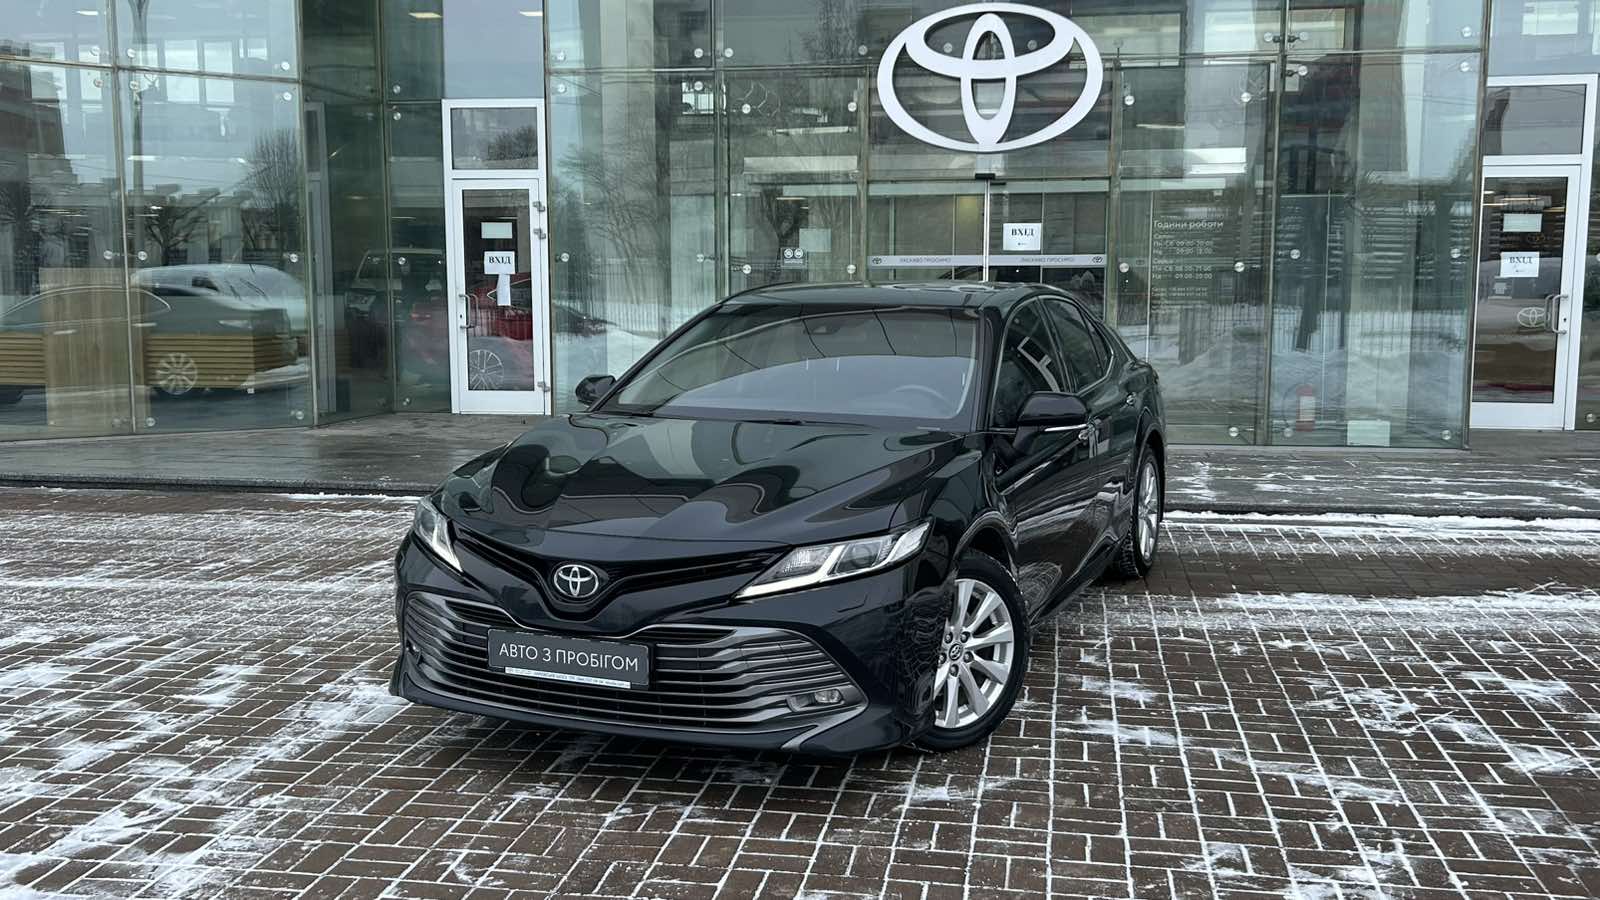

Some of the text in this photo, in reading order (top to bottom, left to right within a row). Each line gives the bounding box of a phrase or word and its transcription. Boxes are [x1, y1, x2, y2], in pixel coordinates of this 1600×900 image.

[1153, 219, 1224, 230] Години роботи
[488, 256, 511, 265] ВХІД
[499, 643, 639, 672] АВТО З ПРОБІГОМ
